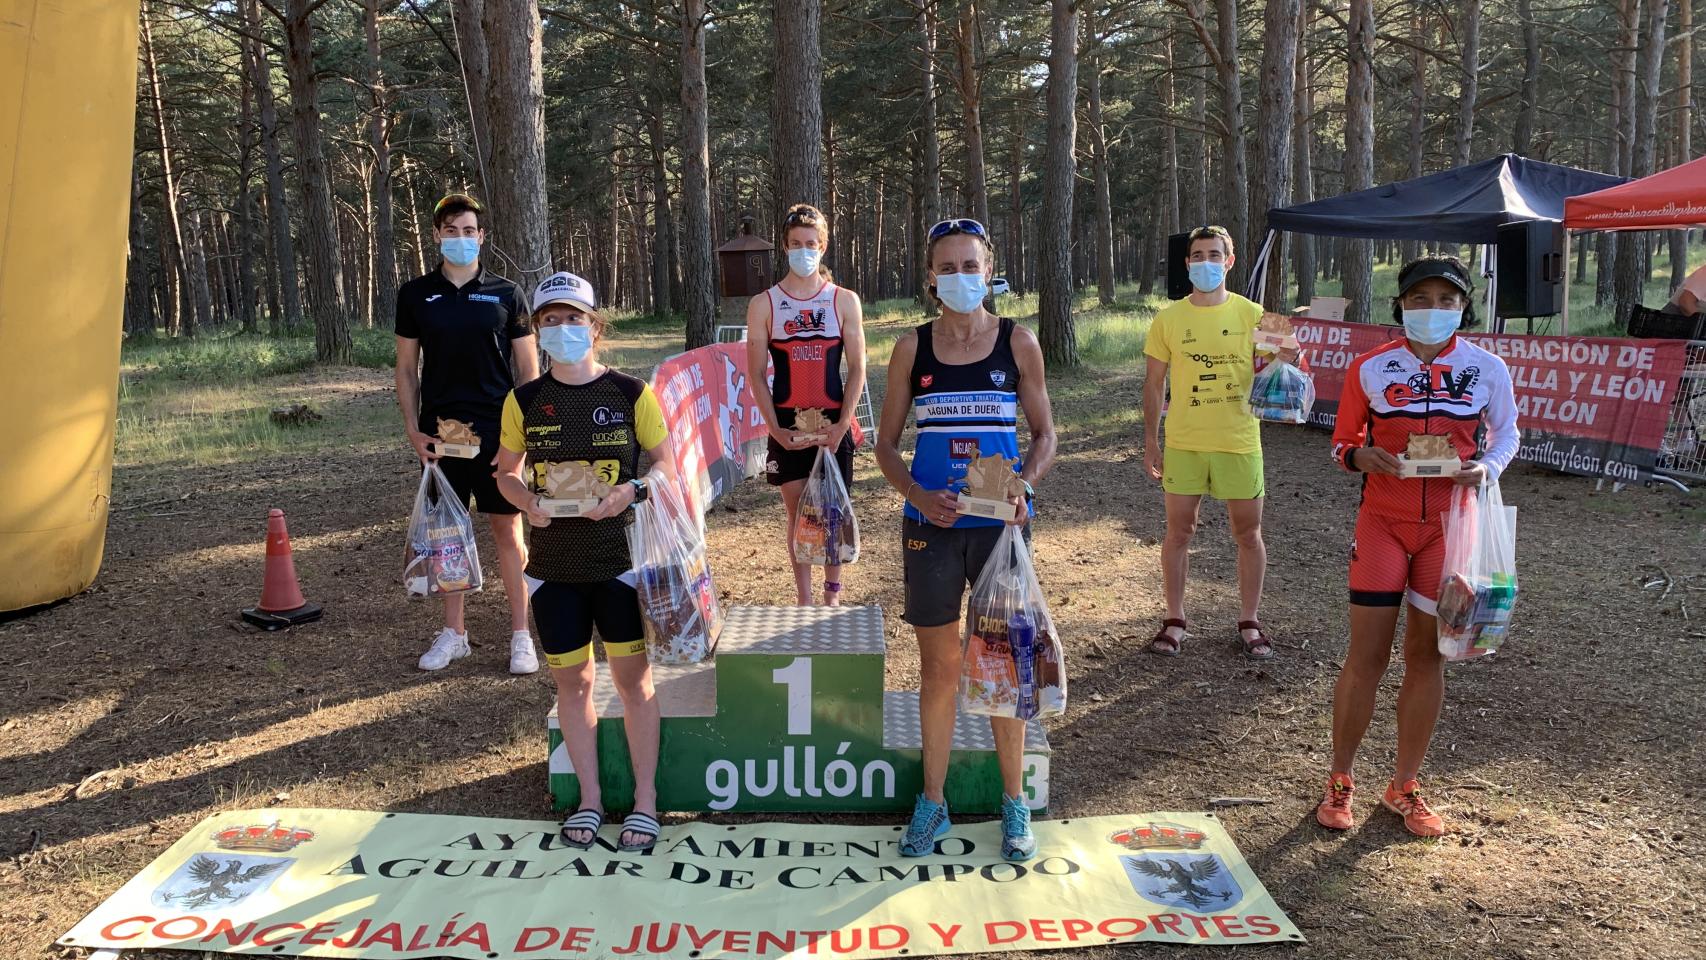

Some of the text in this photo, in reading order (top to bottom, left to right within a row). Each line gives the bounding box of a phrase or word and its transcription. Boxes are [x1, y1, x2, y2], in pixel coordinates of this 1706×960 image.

[1327, 327, 1352, 346] DE
[792, 342, 823, 362] GONZÁLEZ
[1616, 346, 1656, 370] DE
[940, 395, 974, 403] DEPORTIVO
[1568, 370, 1588, 393] Y
[1590, 371, 1666, 404] LEÓN
[928, 405, 1001, 416] LAGUNA DE DUERO
[907, 539, 928, 551] ESP
[773, 656, 812, 736] 1
[705, 742, 896, 810] gullón
[1023, 754, 1049, 810] 3
[325, 854, 1081, 890] AGUILAR DE CAMPOO
[100, 912, 1281, 955] CONCEJALÍA DE JUVENTUD Y DEPORTES
